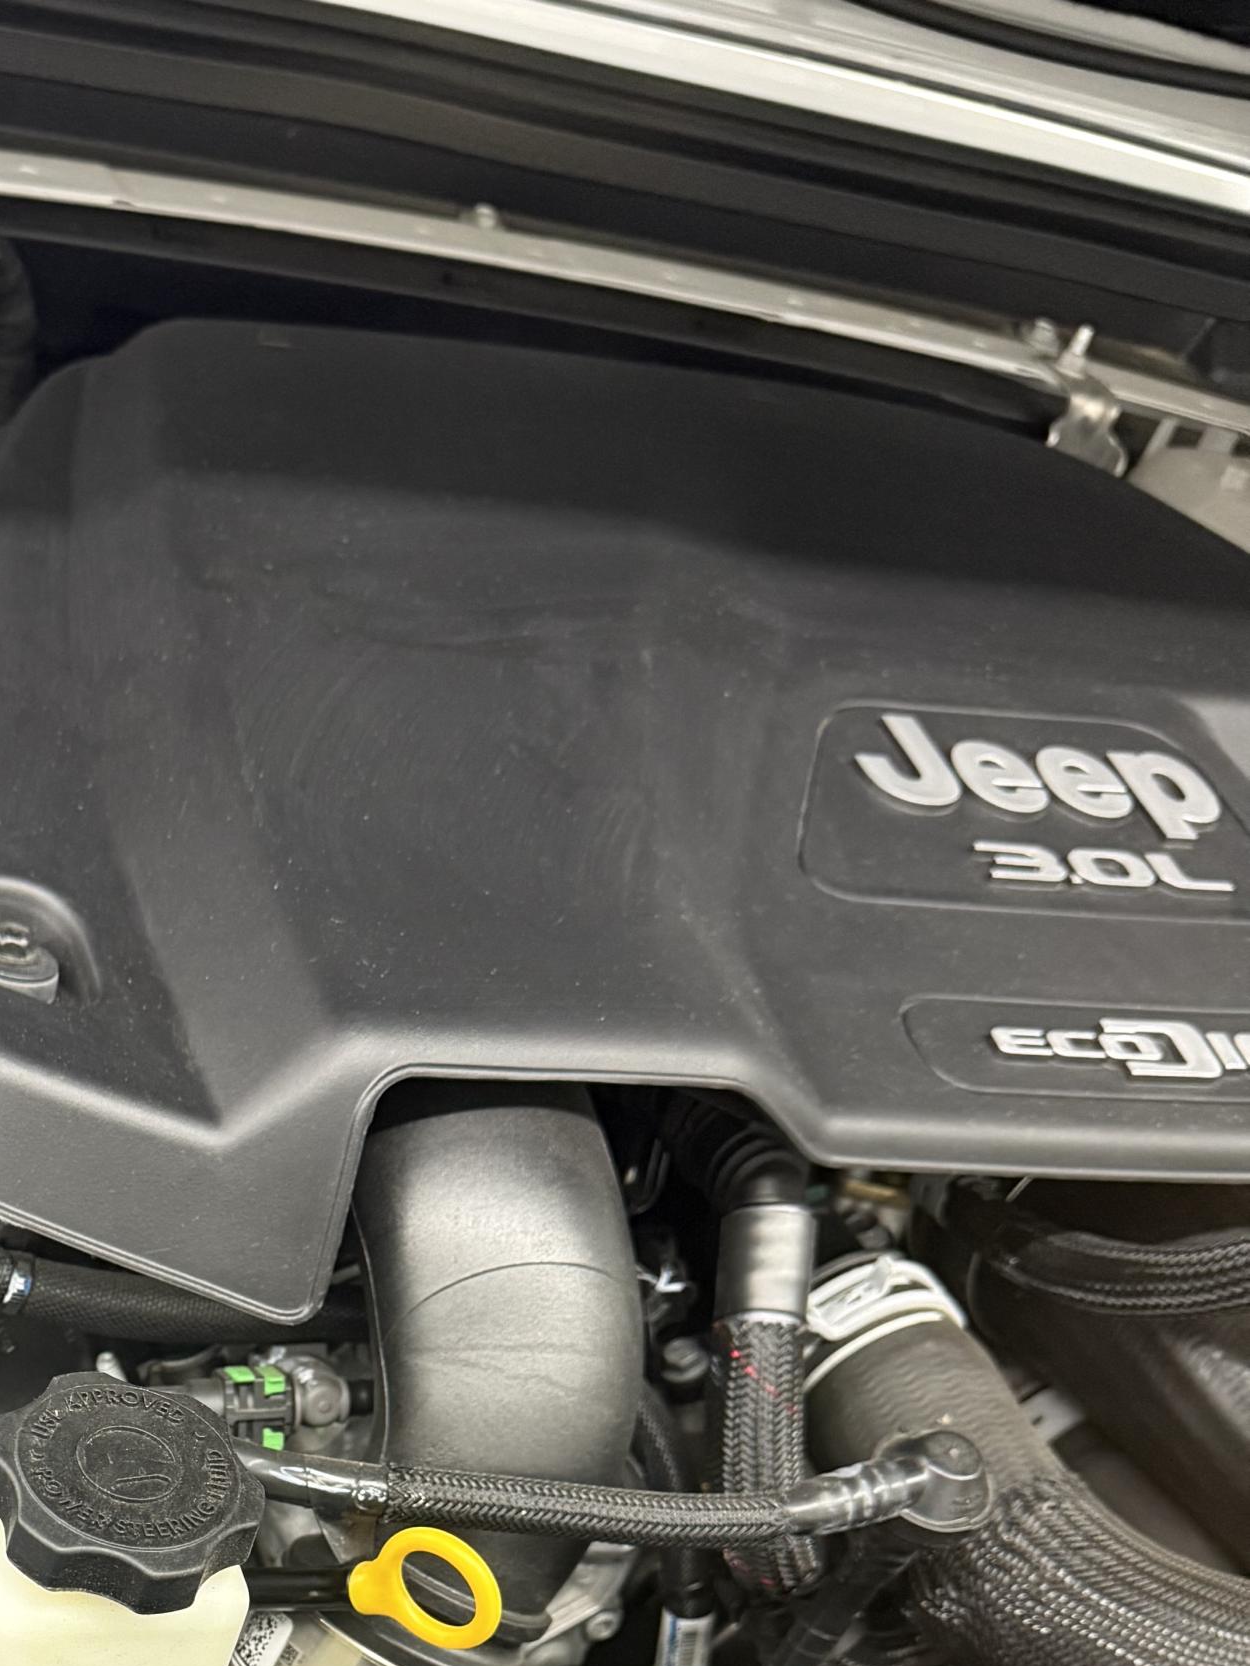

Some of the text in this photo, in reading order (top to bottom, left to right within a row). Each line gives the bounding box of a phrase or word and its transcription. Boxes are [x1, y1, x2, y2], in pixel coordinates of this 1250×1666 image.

[855, 713, 1221, 840] Jeep
[973, 840, 1235, 892] 3.0L
[30, 1387, 187, 1440] USE APPROVED
[33, 1448, 234, 1538] POWER STEERING FLUID
